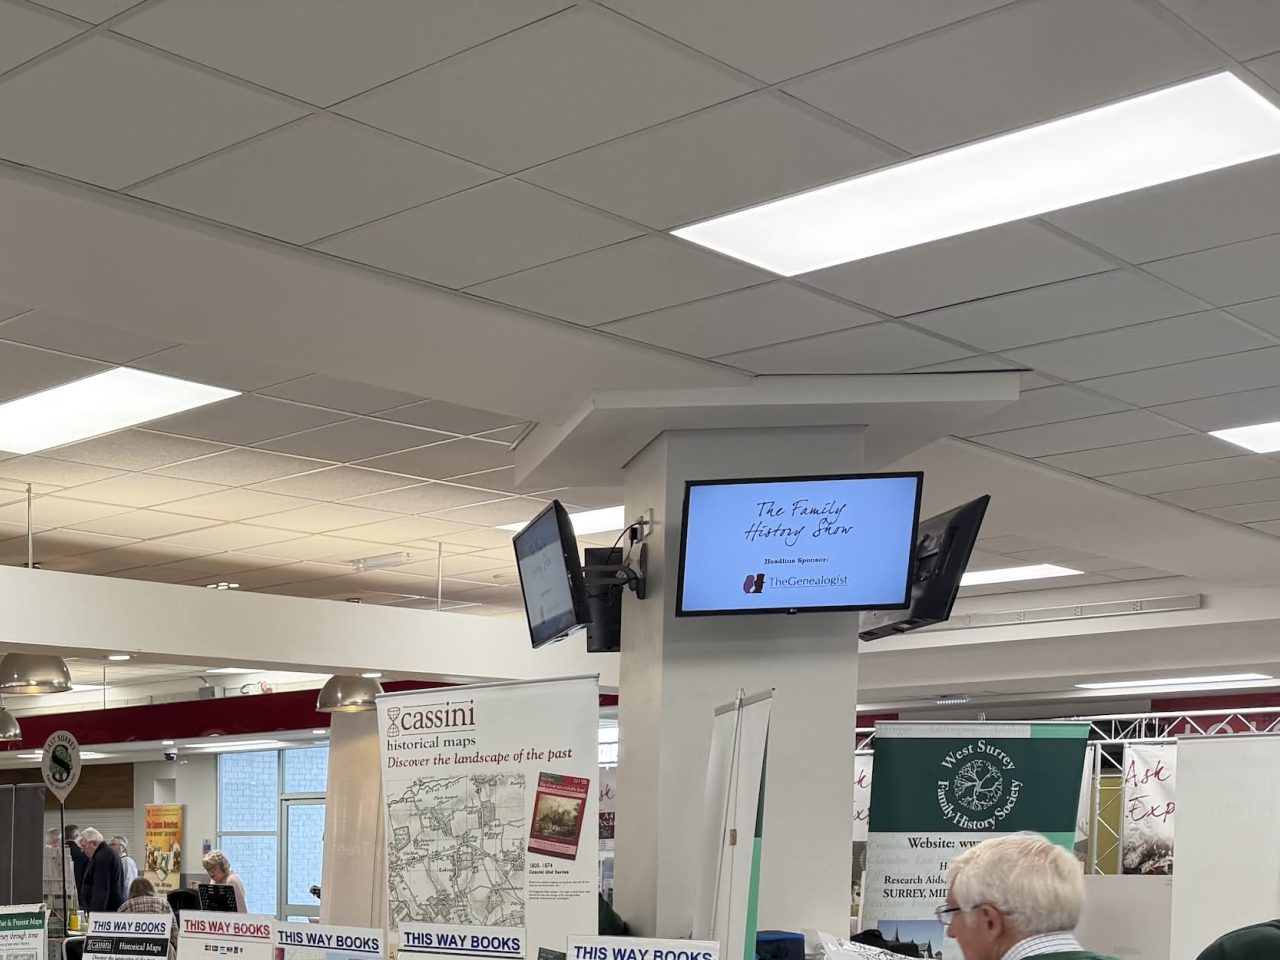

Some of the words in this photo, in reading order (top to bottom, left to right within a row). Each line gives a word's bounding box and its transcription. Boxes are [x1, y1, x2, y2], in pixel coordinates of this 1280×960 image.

[757, 501, 785, 517] The
[791, 499, 846, 524] Family
[745, 521, 805, 546] History
[813, 518, 855, 537] Show
[769, 575, 848, 587] TheGenealogist
[401, 699, 476, 730] cassini
[387, 736, 438, 751] historical
[444, 737, 476, 749] maps
[388, 755, 431, 769] Discover
[434, 754, 450, 766] the
[454, 751, 509, 764] landscape
[513, 748, 523, 763] of
[527, 748, 544, 760] the
[547, 748, 572, 762] past
[941, 744, 975, 770] West
[977, 740, 1016, 771] Surrey
[1125, 759, 1171, 787] Ask
[937, 780, 955, 820] Family
[952, 812, 997, 830] History
[995, 779, 1023, 820] Society
[1126, 795, 1175, 823] Exp
[908, 837, 955, 849] Website:
[884, 876, 922, 884] Research
[925, 875, 947, 884] Aids,
[883, 889, 927, 899] SURREY,
[94, 921, 111, 930] THIS
[114, 922, 133, 931] WAY
[135, 922, 166, 932] BOOKS
[184, 919, 206, 932] THIS
[209, 921, 231, 934] WAY
[233, 922, 270, 936] BOOKS
[119, 942, 144, 950] Historical
[146, 943, 161, 953] Maps
[278, 930, 304, 944] THIS
[306, 932, 333, 947] WAY
[336, 935, 379, 950] BOOKS
[404, 932, 433, 946] THIS
[436, 934, 467, 948] WAY
[471, 935, 520, 951] BOOKS
[574, 945, 608, 960] THIS
